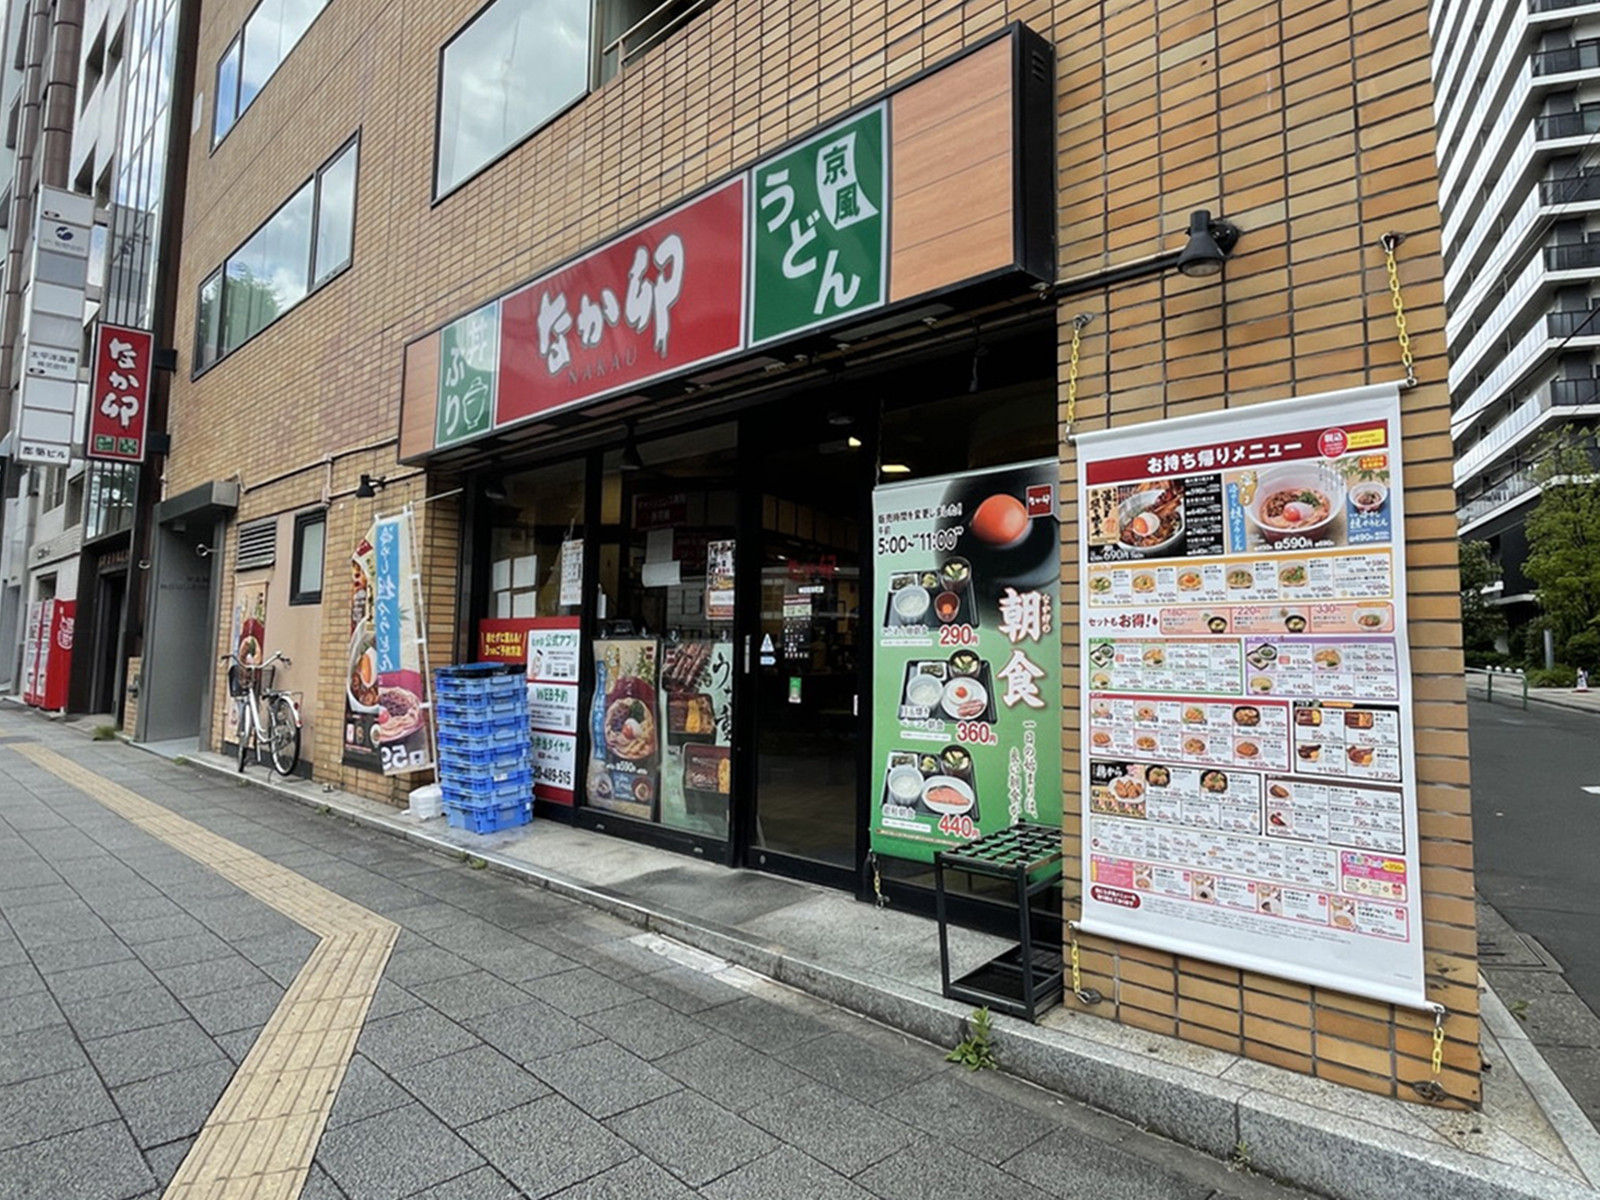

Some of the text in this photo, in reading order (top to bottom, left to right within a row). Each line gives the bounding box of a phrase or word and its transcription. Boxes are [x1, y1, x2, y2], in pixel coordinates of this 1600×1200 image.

[821, 140, 862, 226] 京風
[760, 168, 861, 316] うどん
[536, 233, 685, 376] なか卯
[100, 337, 140, 428] なか卯
[444, 346, 466, 436] ぶり
[567, 347, 638, 385] NAKAU
[1146, 441, 1303, 474] お持ち帰りメニュー
[940, 624, 979, 646] 290円
[997, 587, 1047, 709] 朝食
[1088, 613, 1151, 628] セットもお得!
[956, 722, 997, 745] 360円
[938, 815, 980, 838] 440円
